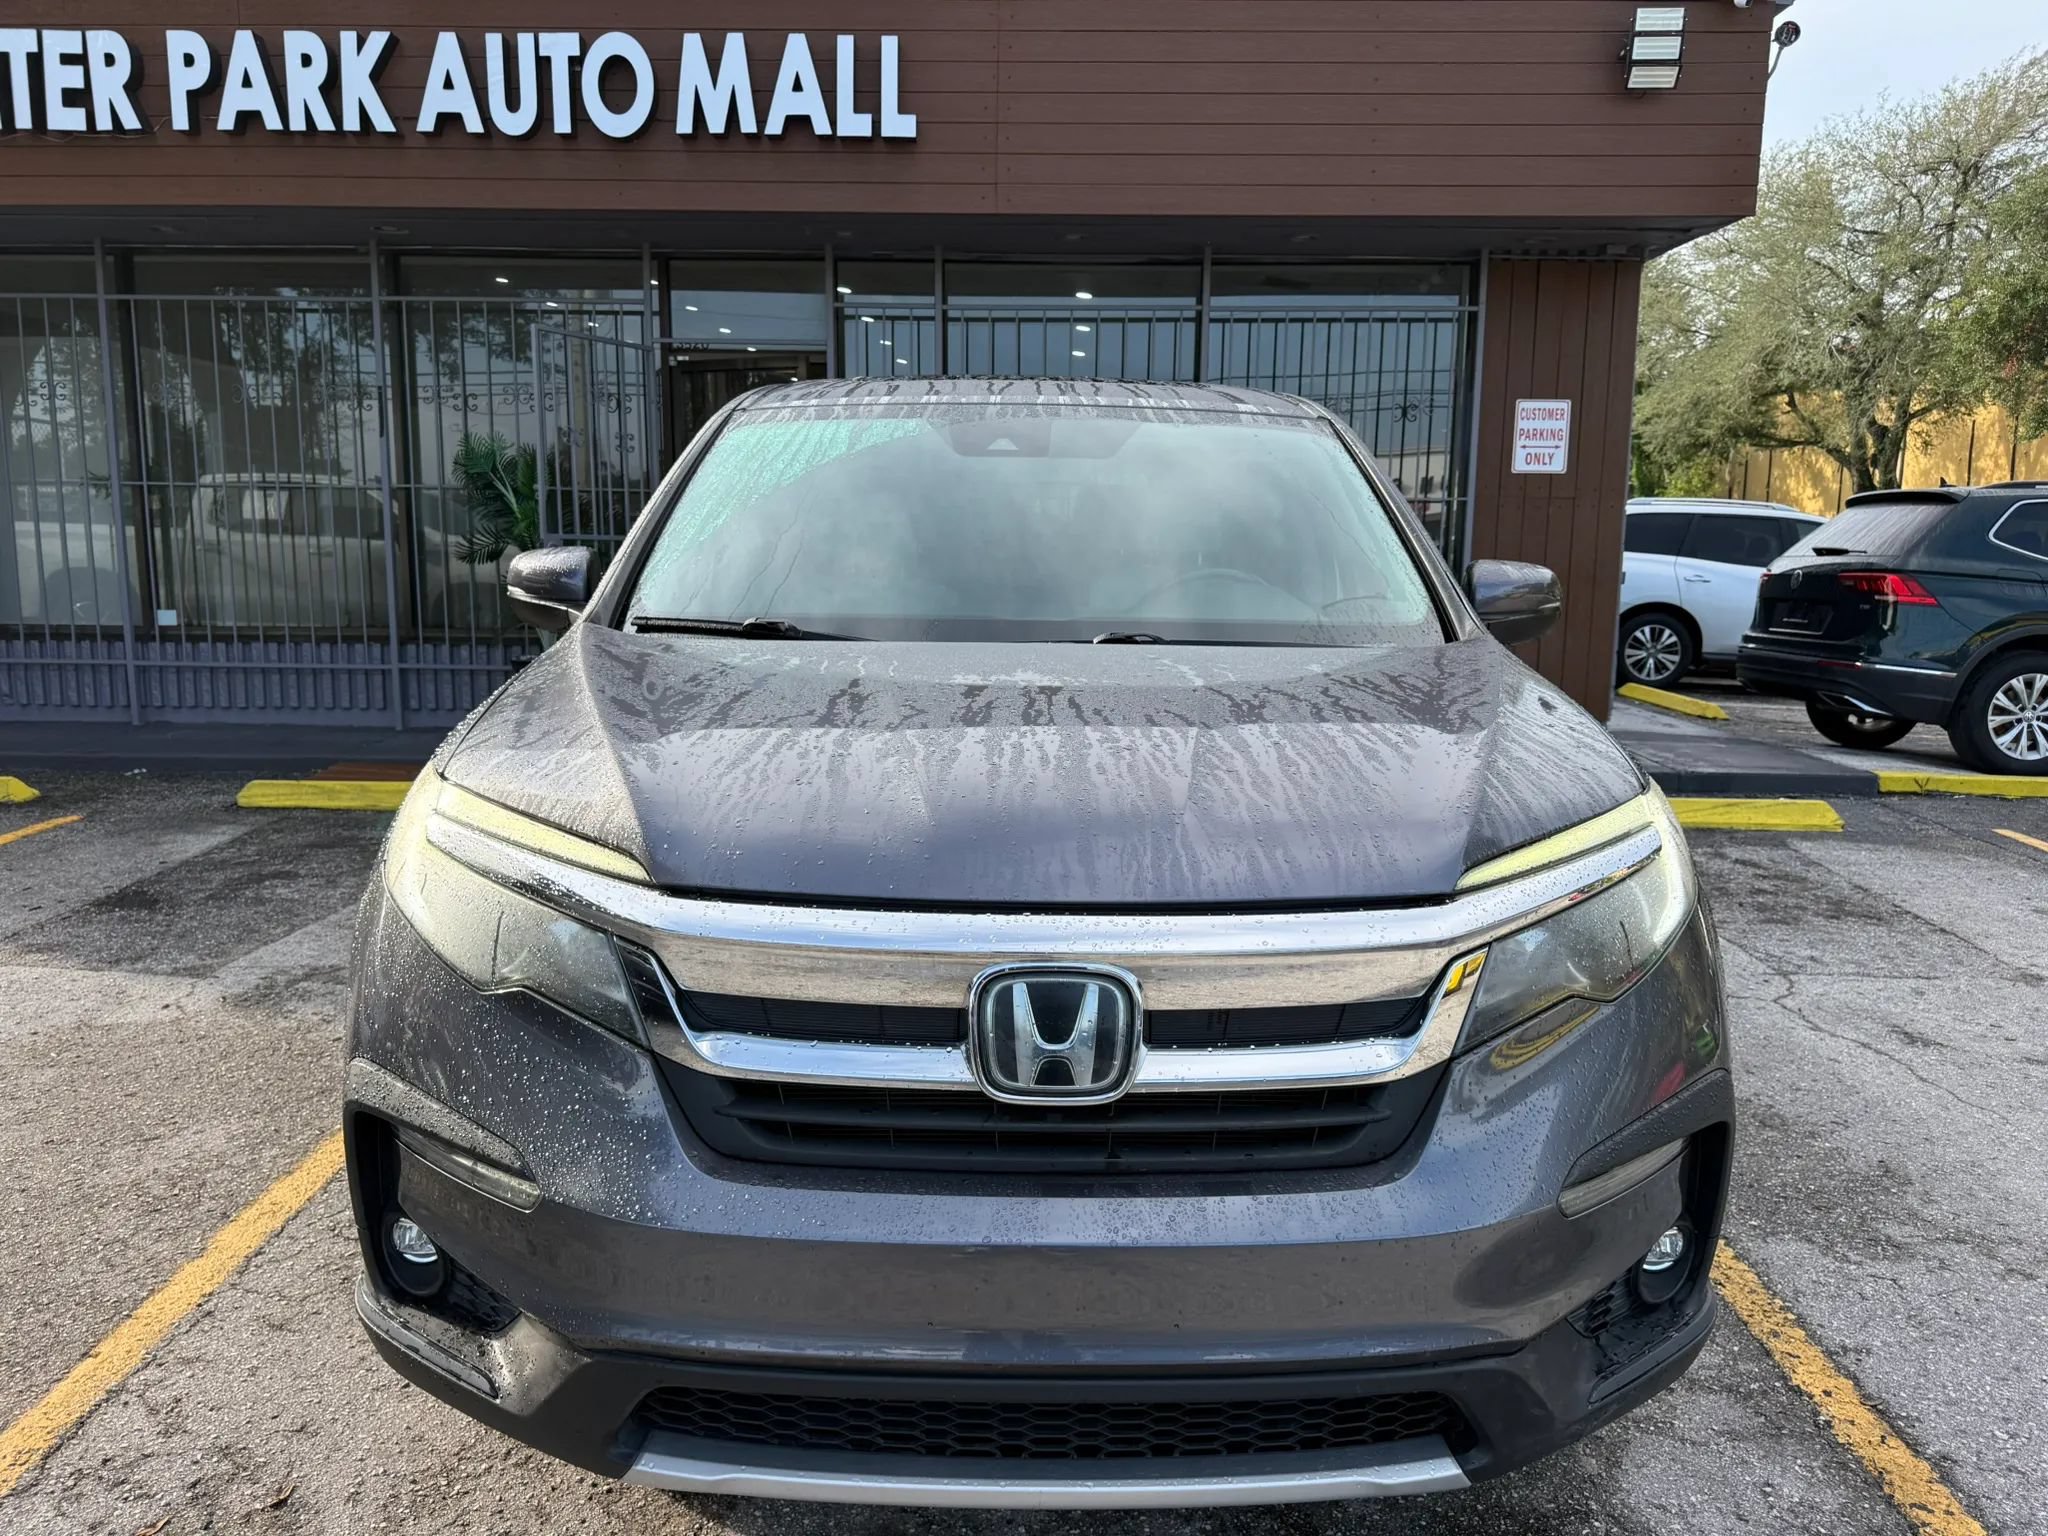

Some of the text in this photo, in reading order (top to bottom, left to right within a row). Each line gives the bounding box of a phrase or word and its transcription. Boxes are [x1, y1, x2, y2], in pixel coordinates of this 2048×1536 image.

[0, 28, 917, 138] TER PARK AUTO MALL
[1520, 407, 1566, 421] CUSTOMER
[1518, 428, 1564, 441] PARKING
[1525, 452, 1555, 466] ONLY
